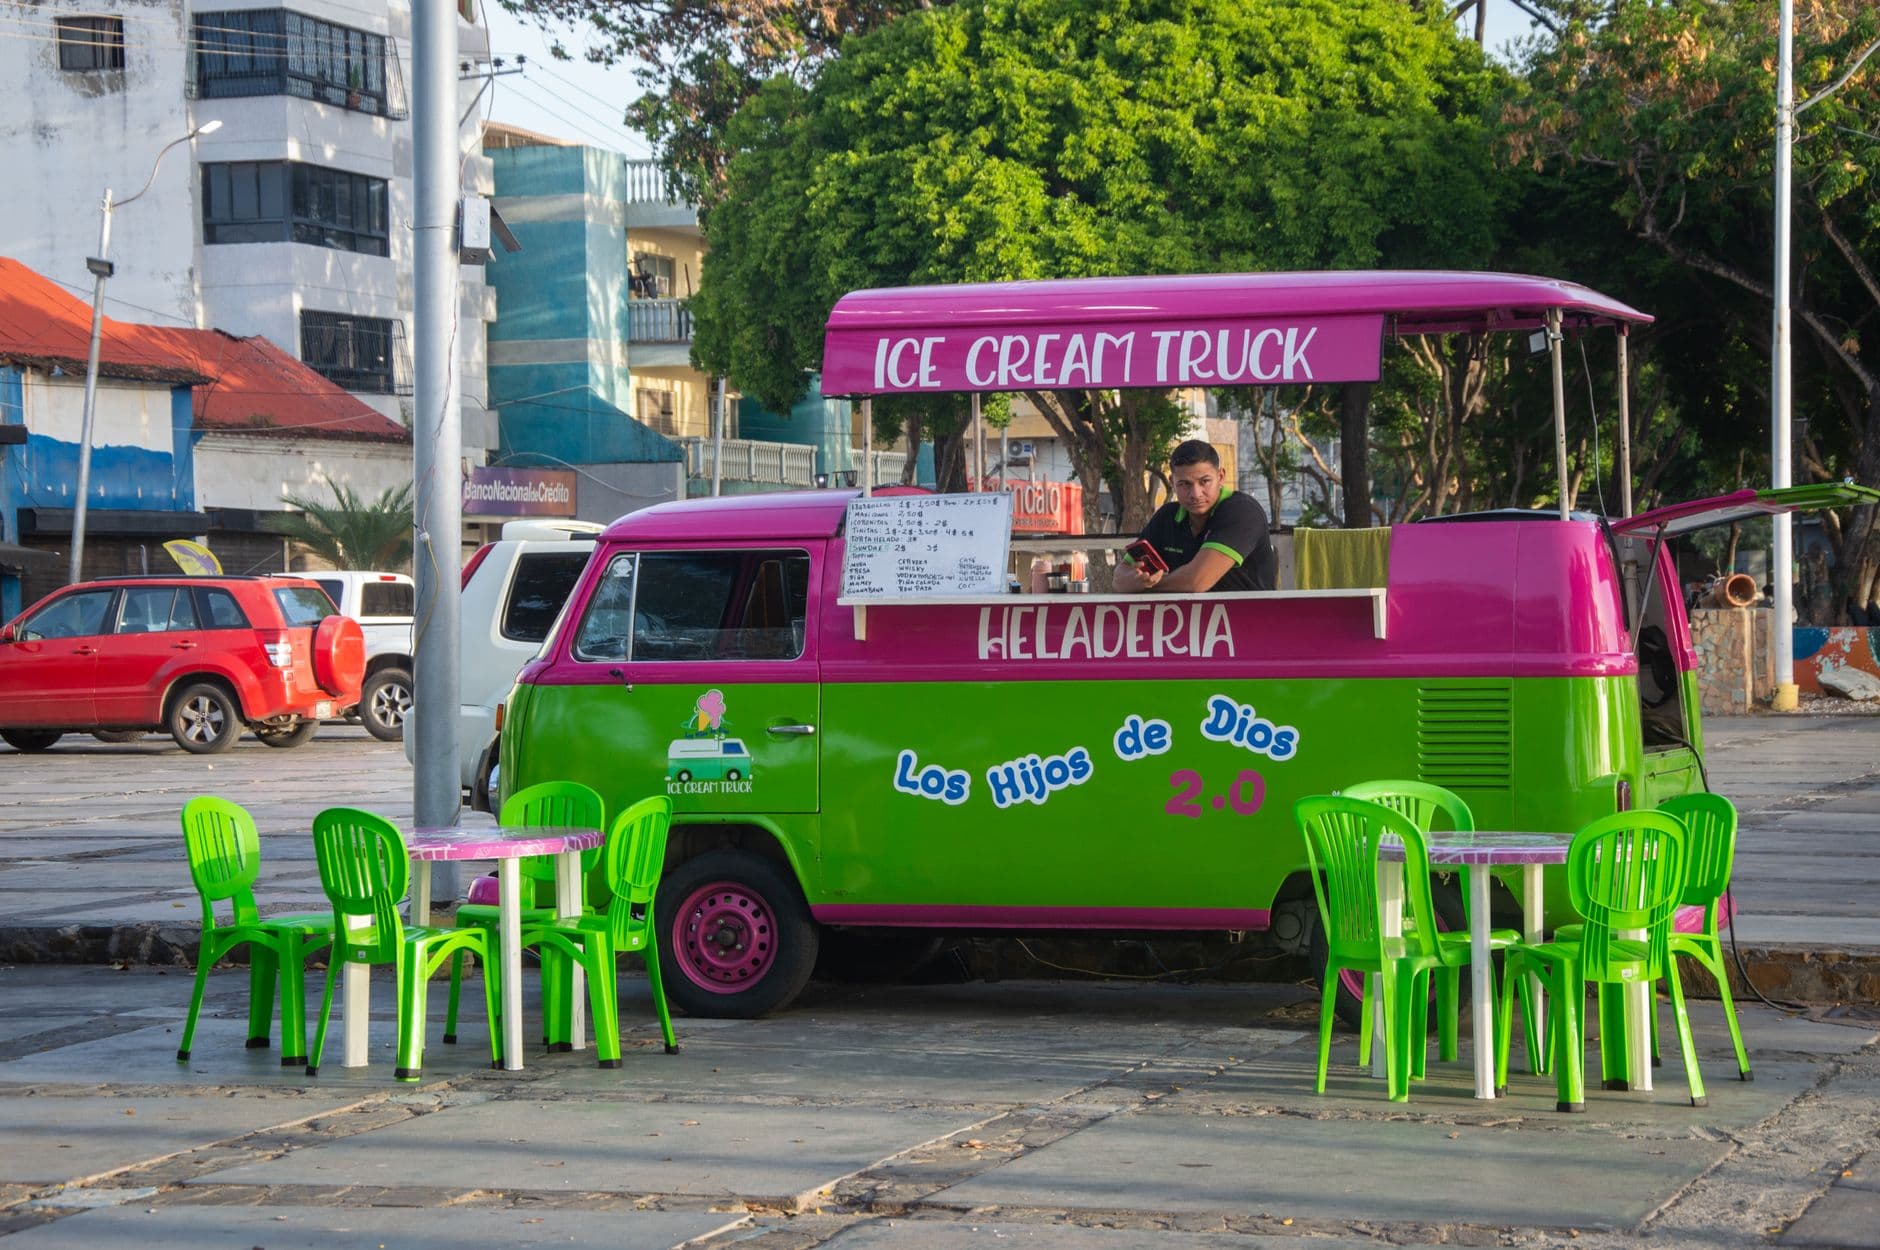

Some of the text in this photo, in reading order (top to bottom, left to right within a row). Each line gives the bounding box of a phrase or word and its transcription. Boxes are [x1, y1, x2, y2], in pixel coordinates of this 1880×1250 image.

[875, 326, 1317, 388] ICE CREAM TRUCK
[978, 603, 1235, 660] HELADERIA
[893, 694, 1300, 809] Los Hijos de Dios
[667, 781, 753, 795] ICE CREAM TRUCK
[1164, 769, 1266, 819] 2.0
